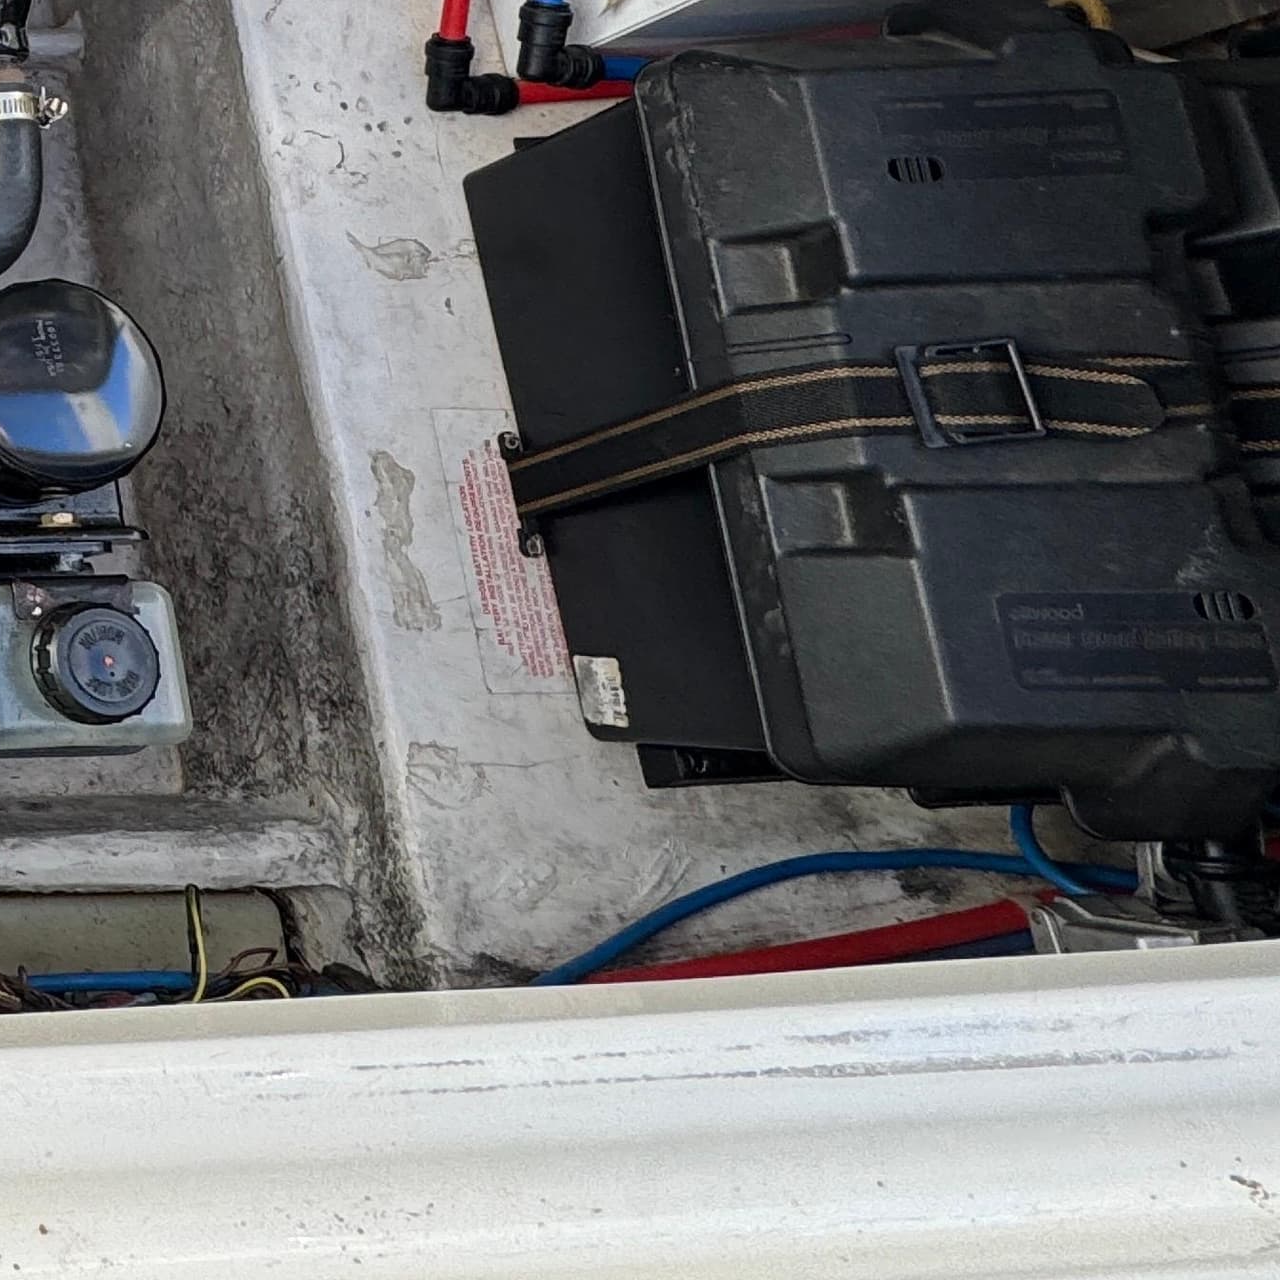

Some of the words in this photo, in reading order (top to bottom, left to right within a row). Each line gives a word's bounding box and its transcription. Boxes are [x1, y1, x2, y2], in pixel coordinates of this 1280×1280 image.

[457, 484, 473, 531] LOCATION
[461, 458, 483, 532] REQUIREMENTS
[467, 534, 482, 576] BATTERY
[476, 533, 497, 600] INSTALLATION
[491, 602, 506, 644] BATTERY
